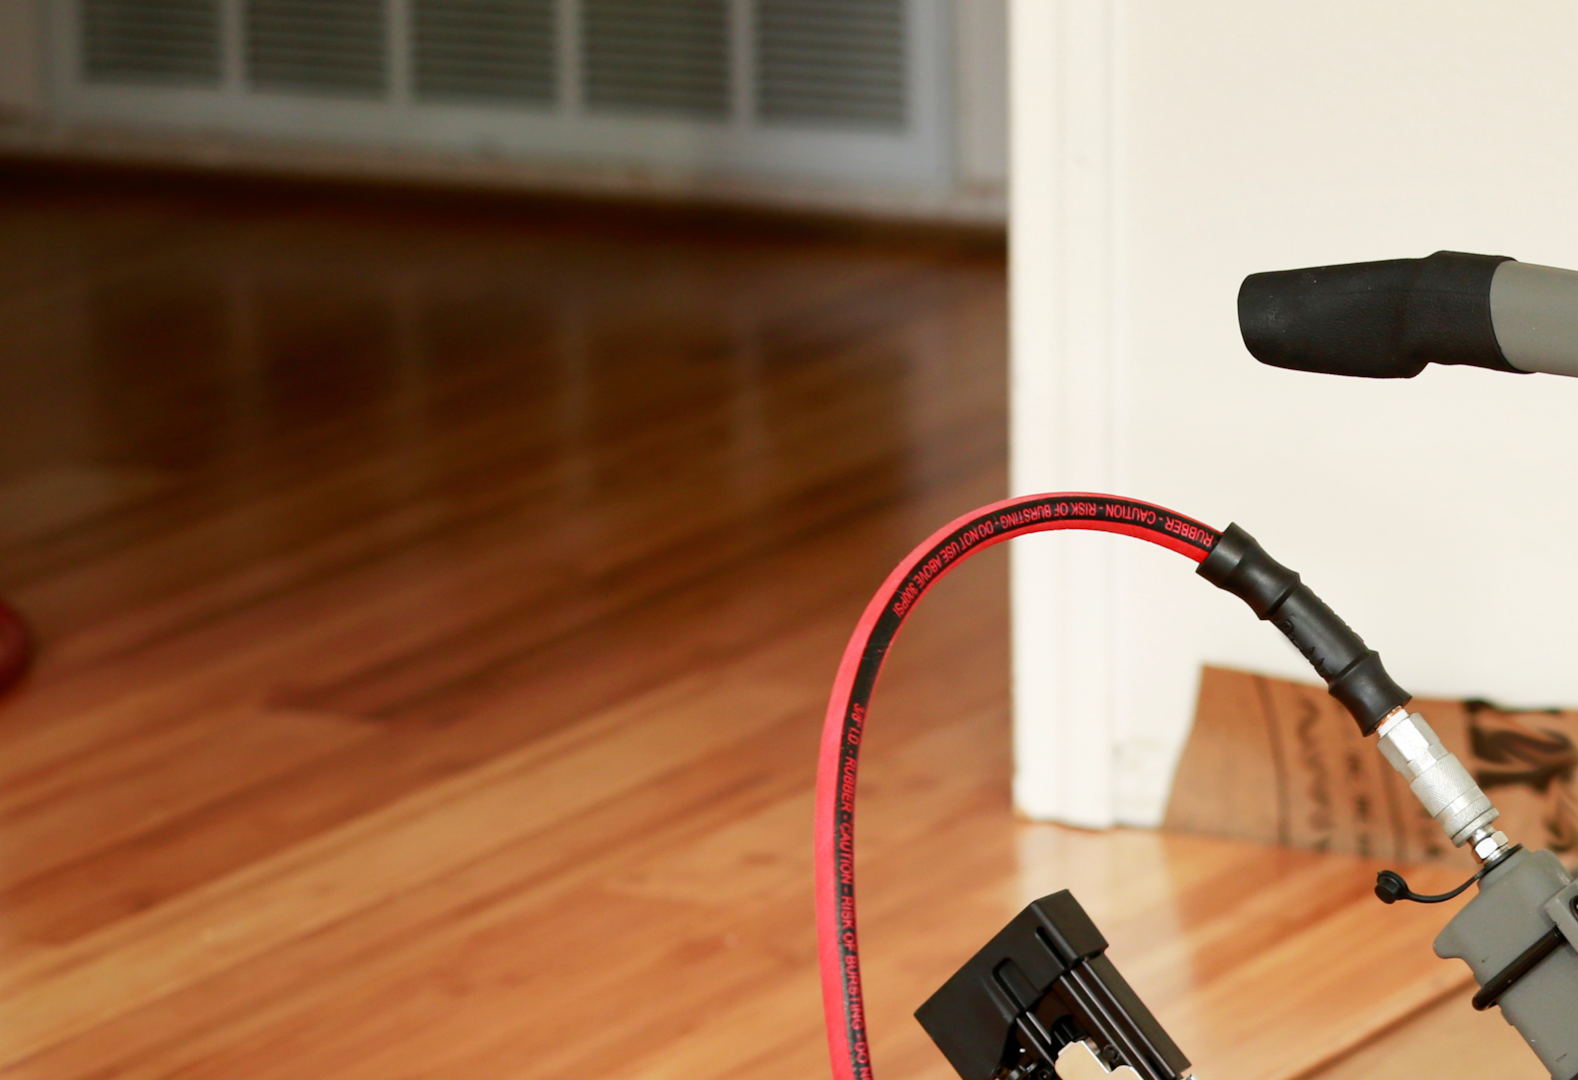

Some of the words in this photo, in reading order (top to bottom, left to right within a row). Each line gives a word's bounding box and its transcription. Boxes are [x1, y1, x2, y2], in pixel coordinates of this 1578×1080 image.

[1001, 503, 1052, 529] BURSTING
[1054, 502, 1069, 517] OF
[1070, 502, 1097, 516] RISK
[1105, 503, 1157, 525] CAUTION
[958, 527, 980, 550] NOT
[977, 520, 995, 537] DO
[1164, 516, 1215, 547] RUBBER
[940, 541, 961, 563] USE
[913, 554, 943, 588] ABOVE
[841, 755, 857, 812] RUBBER
[839, 822, 853, 885] CAUTION
[841, 895, 855, 930] RISK
[842, 931, 857, 952] OF
[844, 954, 864, 1030] BURSTING
[853, 1041, 869, 1064] DO
